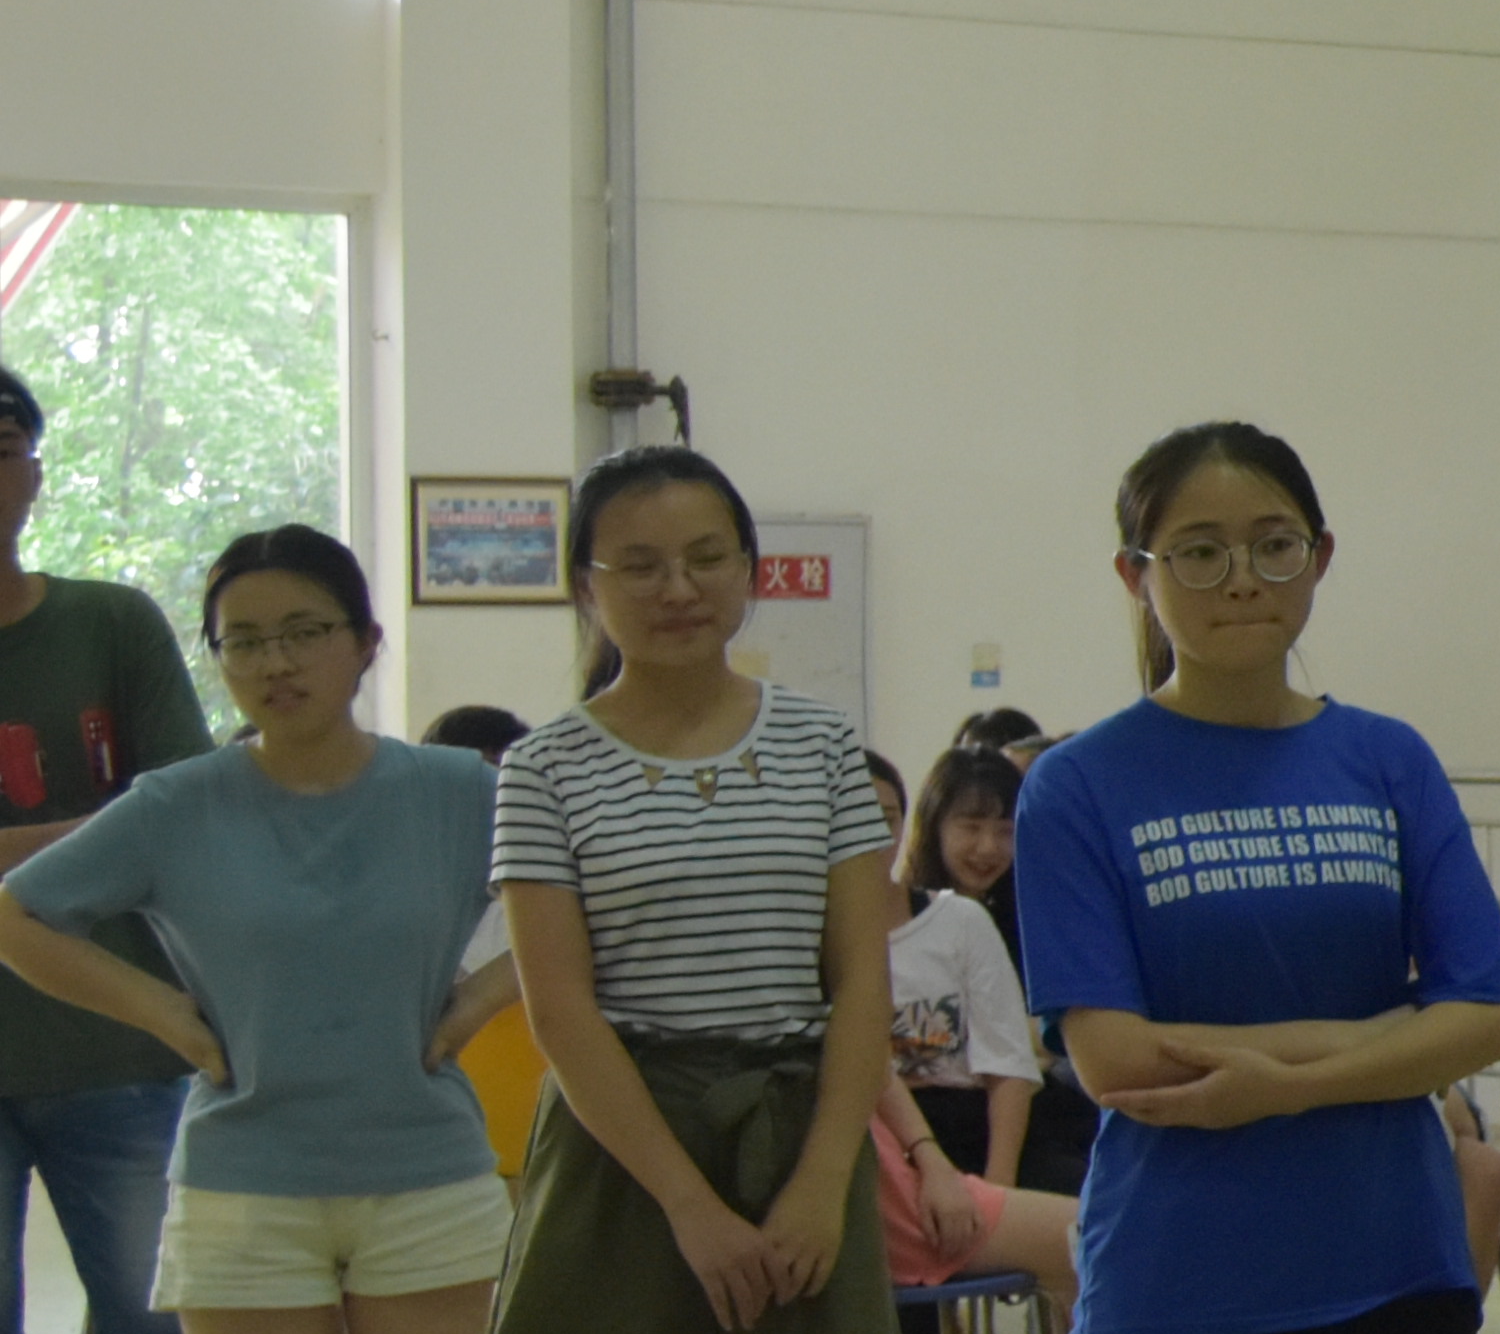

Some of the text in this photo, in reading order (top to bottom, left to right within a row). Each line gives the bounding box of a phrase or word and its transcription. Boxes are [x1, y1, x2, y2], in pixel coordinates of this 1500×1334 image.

[766, 557, 825, 592] 火栓
[1130, 817, 1177, 847] BOD
[1279, 805, 1302, 828] IS
[1305, 804, 1382, 829] ALWAYS
[1138, 845, 1185, 876] BOD
[1286, 834, 1310, 856] IS
[1313, 831, 1387, 858] ALWAYS
[1145, 874, 1191, 907] BOD
[1293, 862, 1316, 885] IS
[1320, 860, 1391, 888] ALWAYS
